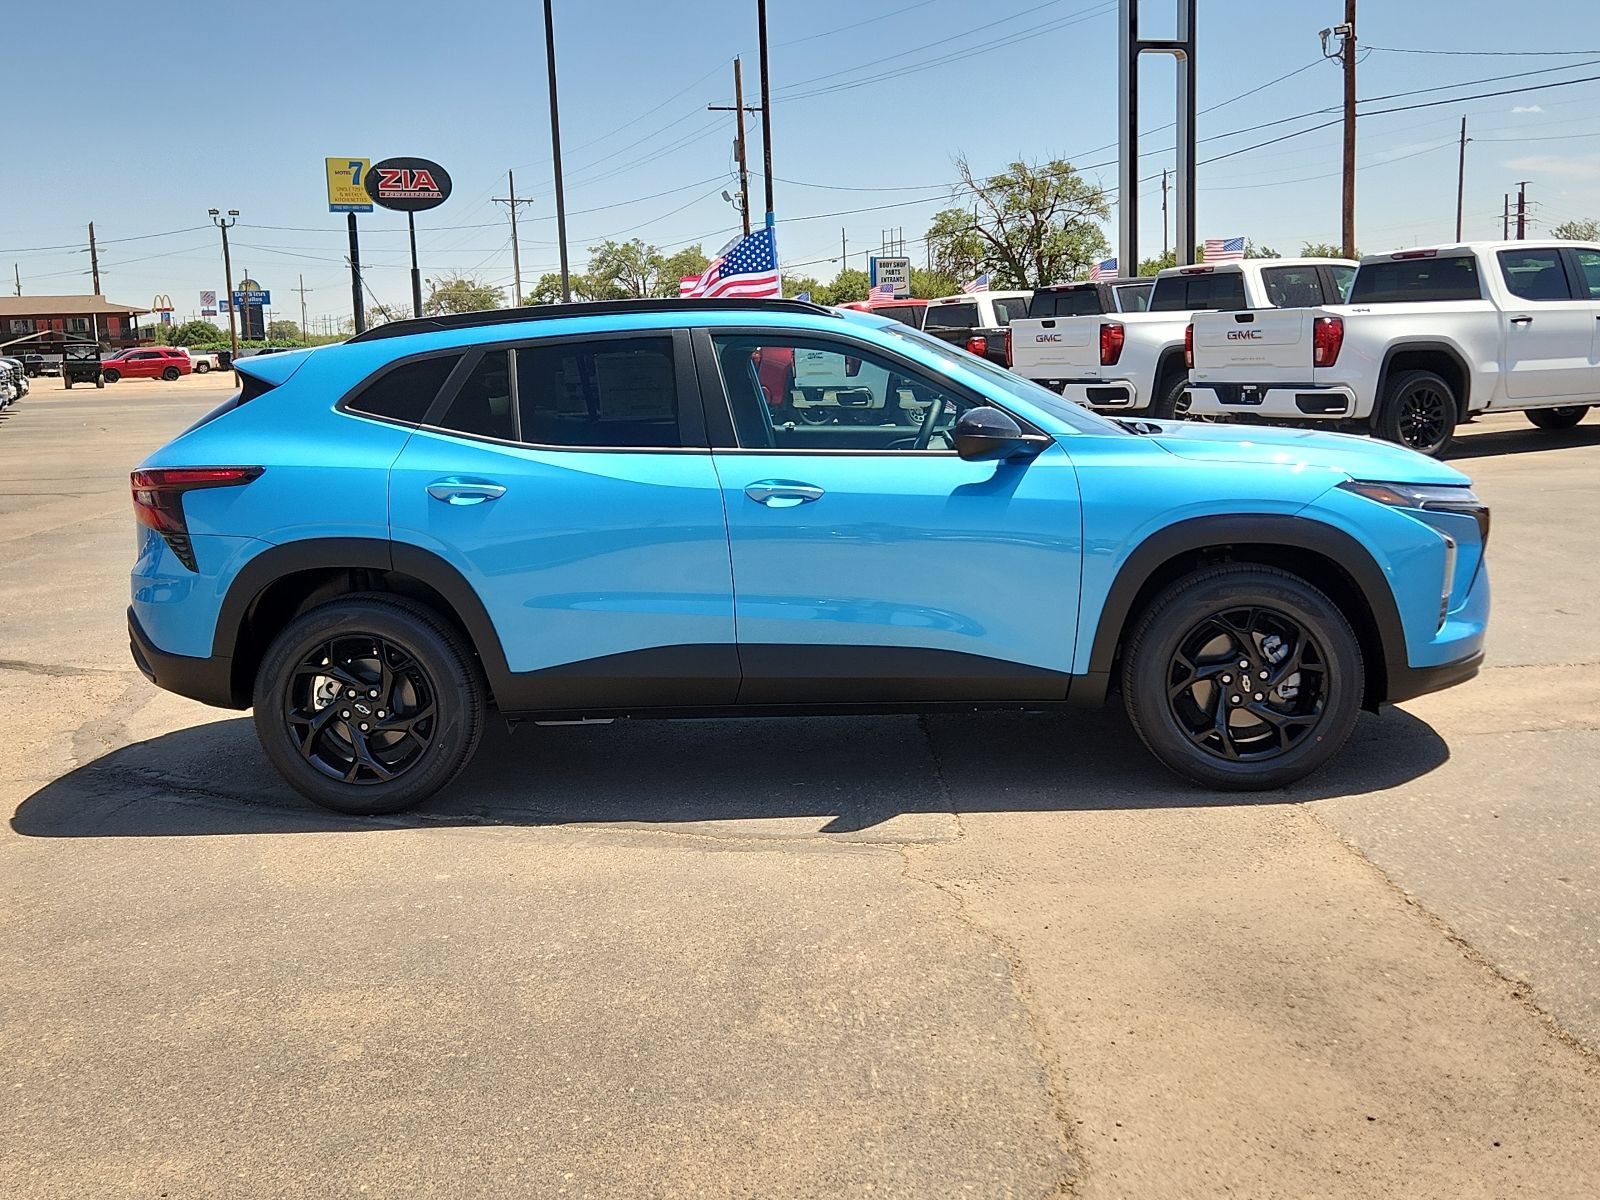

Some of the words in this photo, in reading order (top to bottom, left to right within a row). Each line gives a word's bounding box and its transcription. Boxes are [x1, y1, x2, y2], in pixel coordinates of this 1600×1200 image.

[348, 161, 363, 185] 7
[377, 169, 439, 190] ZIA
[1035, 334, 1062, 342] GMC
[1227, 330, 1263, 340] GMC
